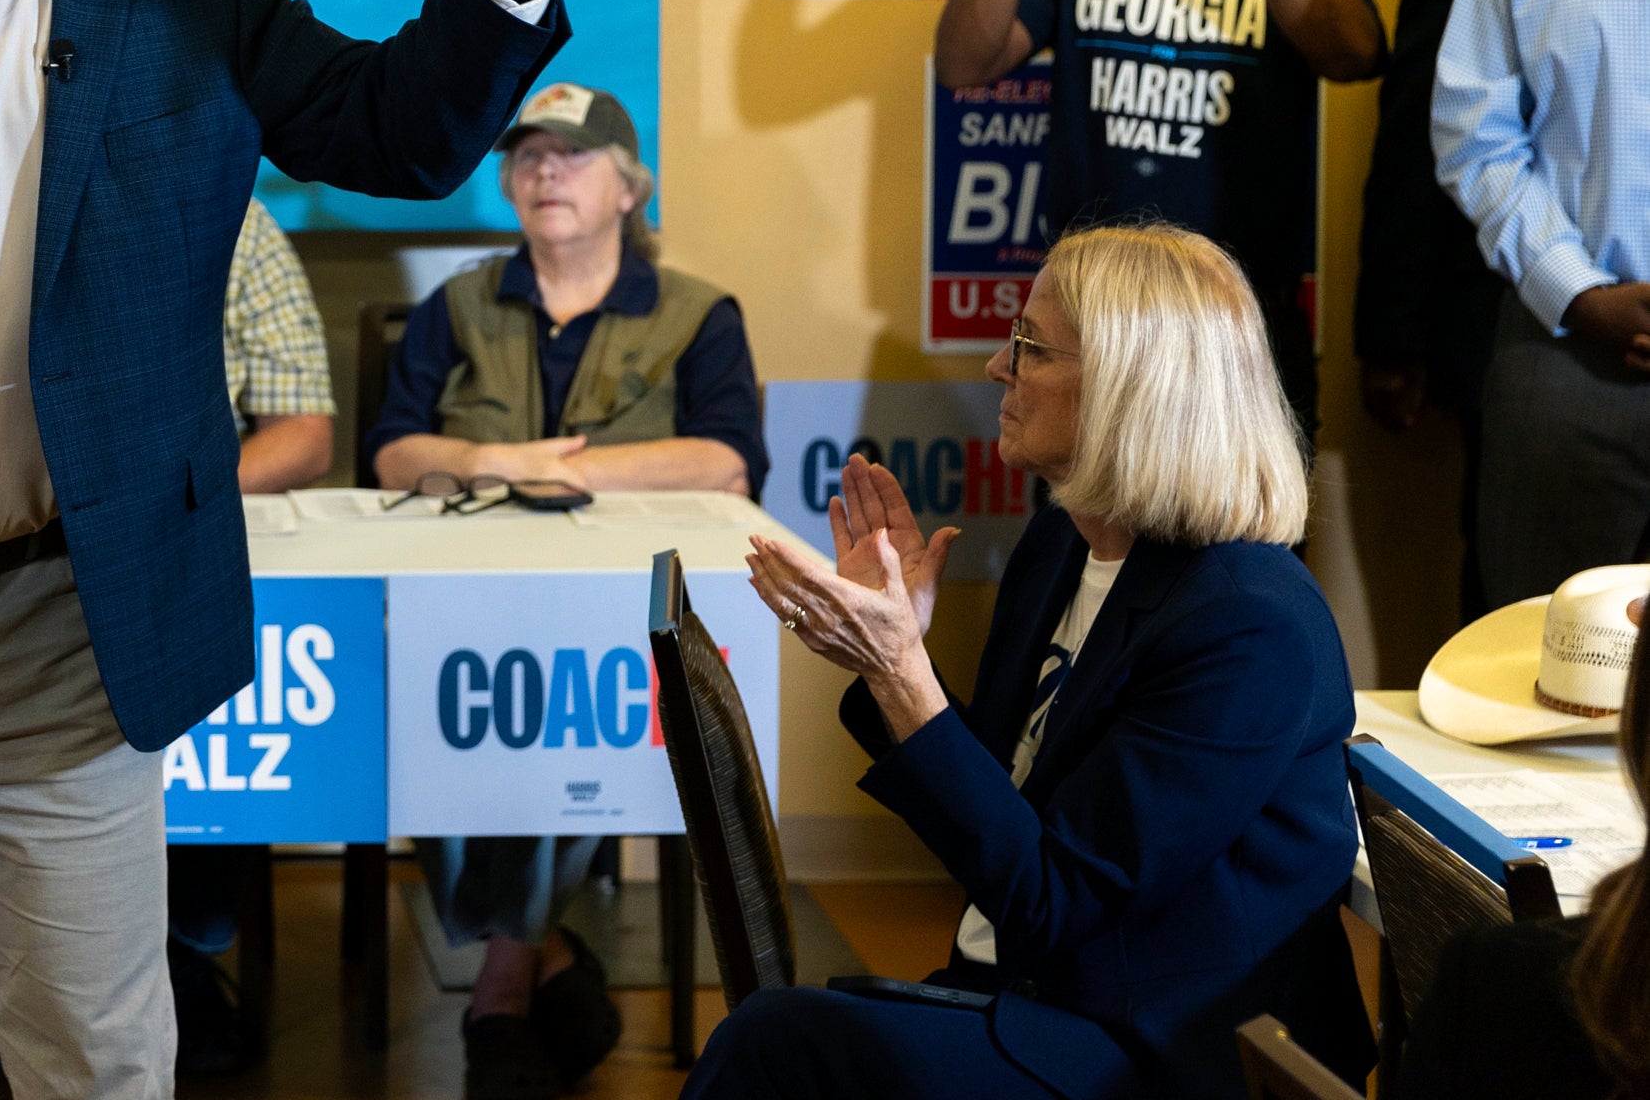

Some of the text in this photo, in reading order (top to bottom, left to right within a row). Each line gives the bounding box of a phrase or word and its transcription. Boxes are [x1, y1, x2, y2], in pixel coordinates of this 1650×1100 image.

[1090, 56, 1235, 126] HARRIS
[958, 112, 1051, 147] SANF
[1105, 114, 1204, 160] WALZ
[437, 646, 668, 751] COAC
[162, 733, 292, 791] ALZ
